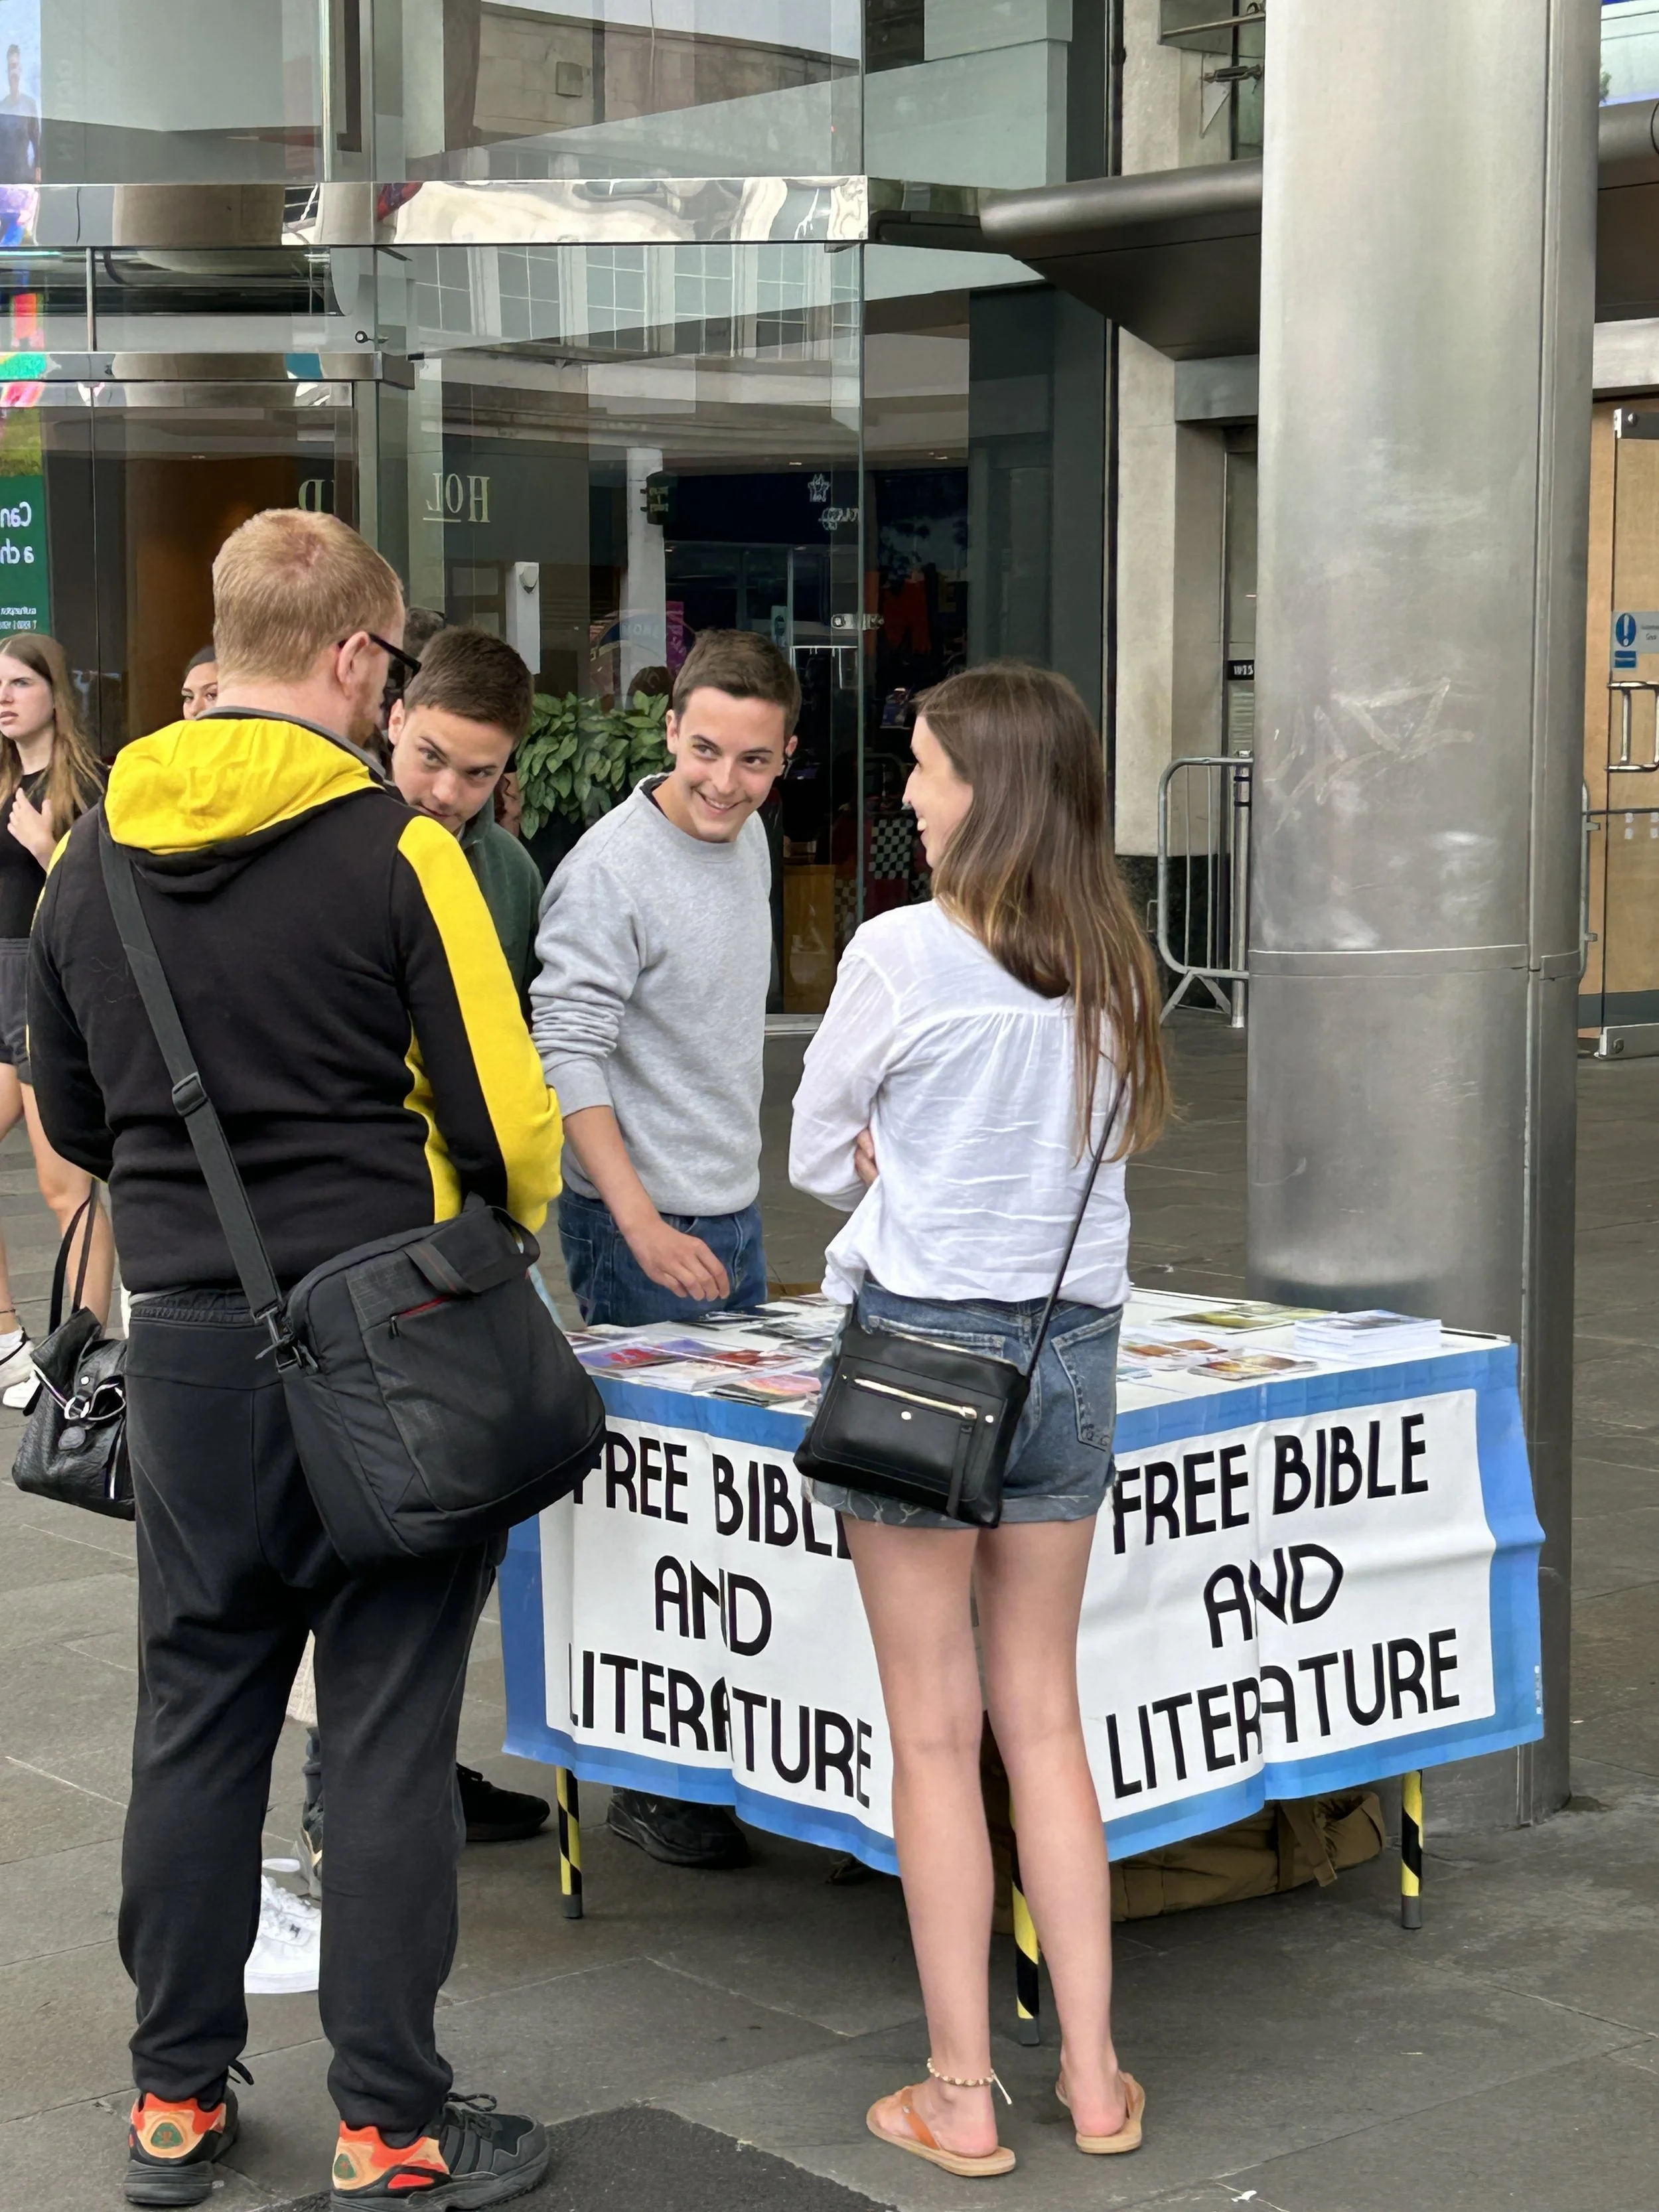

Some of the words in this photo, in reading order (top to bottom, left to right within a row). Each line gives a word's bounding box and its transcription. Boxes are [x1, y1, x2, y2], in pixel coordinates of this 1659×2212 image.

[1112, 1443, 1249, 1554] FREE
[1273, 1413, 1428, 1515] BIBLE
[655, 1555, 772, 1657] AND
[1204, 1543, 1344, 1649] AND
[1106, 1628, 1460, 1799] LITERATURE
